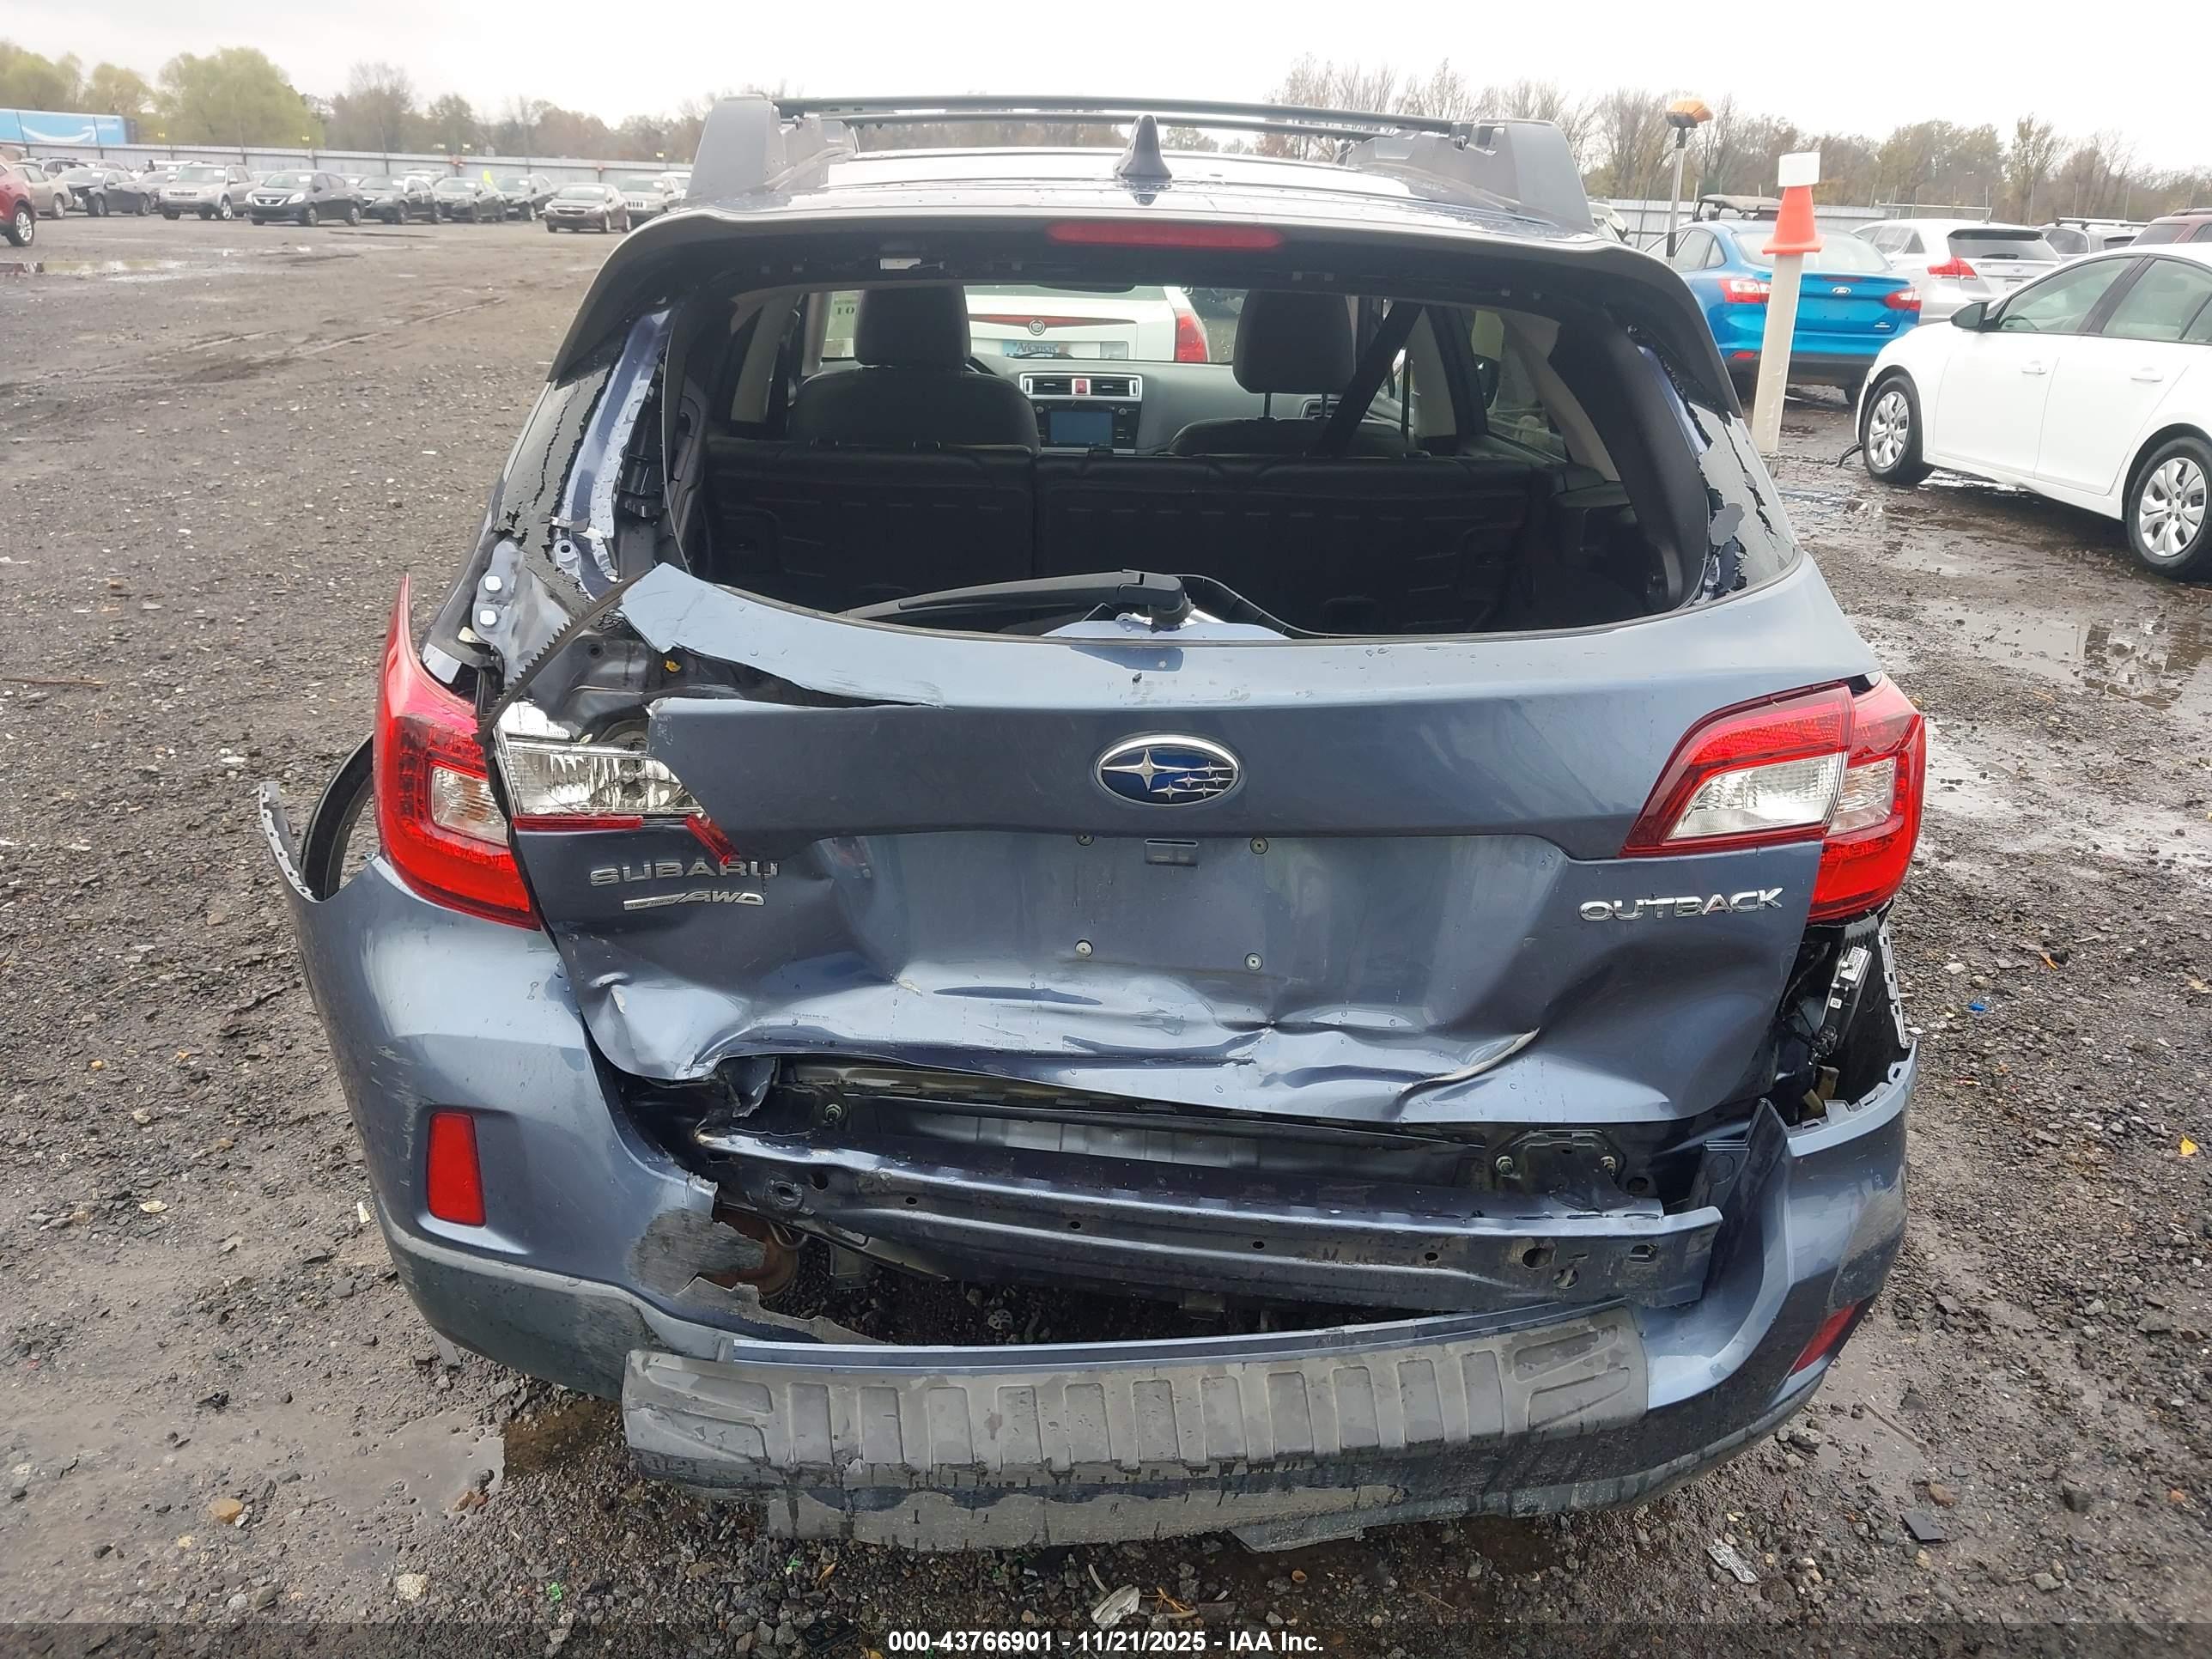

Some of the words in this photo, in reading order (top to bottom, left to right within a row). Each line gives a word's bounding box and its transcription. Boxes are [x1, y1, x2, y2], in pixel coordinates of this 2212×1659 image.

[590, 859, 779, 886] SUBARU
[678, 890, 764, 906] AWD
[1578, 887, 1784, 921] OUTBACK
